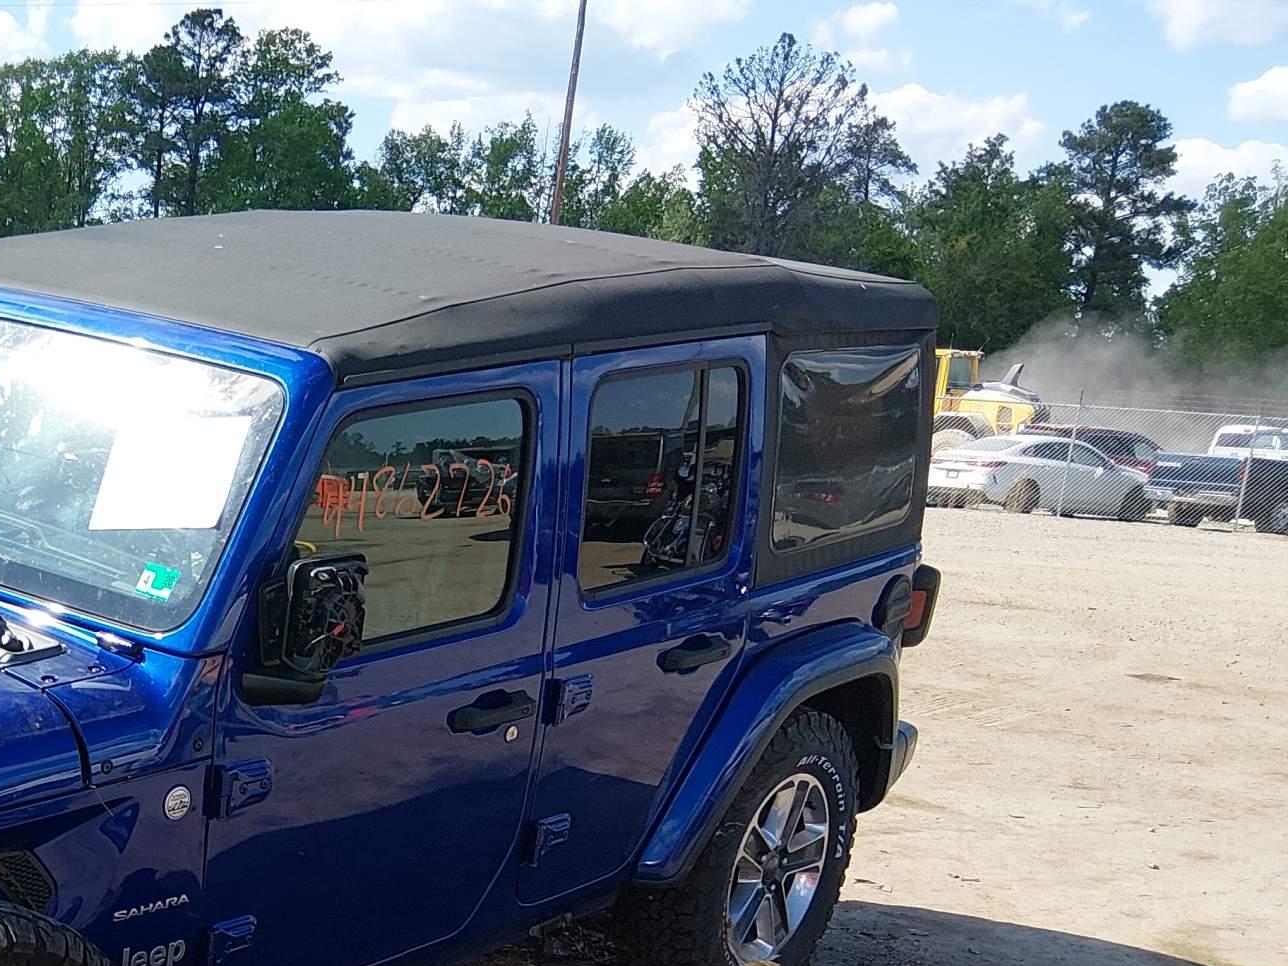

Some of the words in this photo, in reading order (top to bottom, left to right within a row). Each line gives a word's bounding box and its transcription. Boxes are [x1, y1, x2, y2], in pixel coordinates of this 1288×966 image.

[795, 754, 846, 812] All-Terrain
[834, 821, 846, 859] T/A
[113, 894, 190, 922] SAHARA
